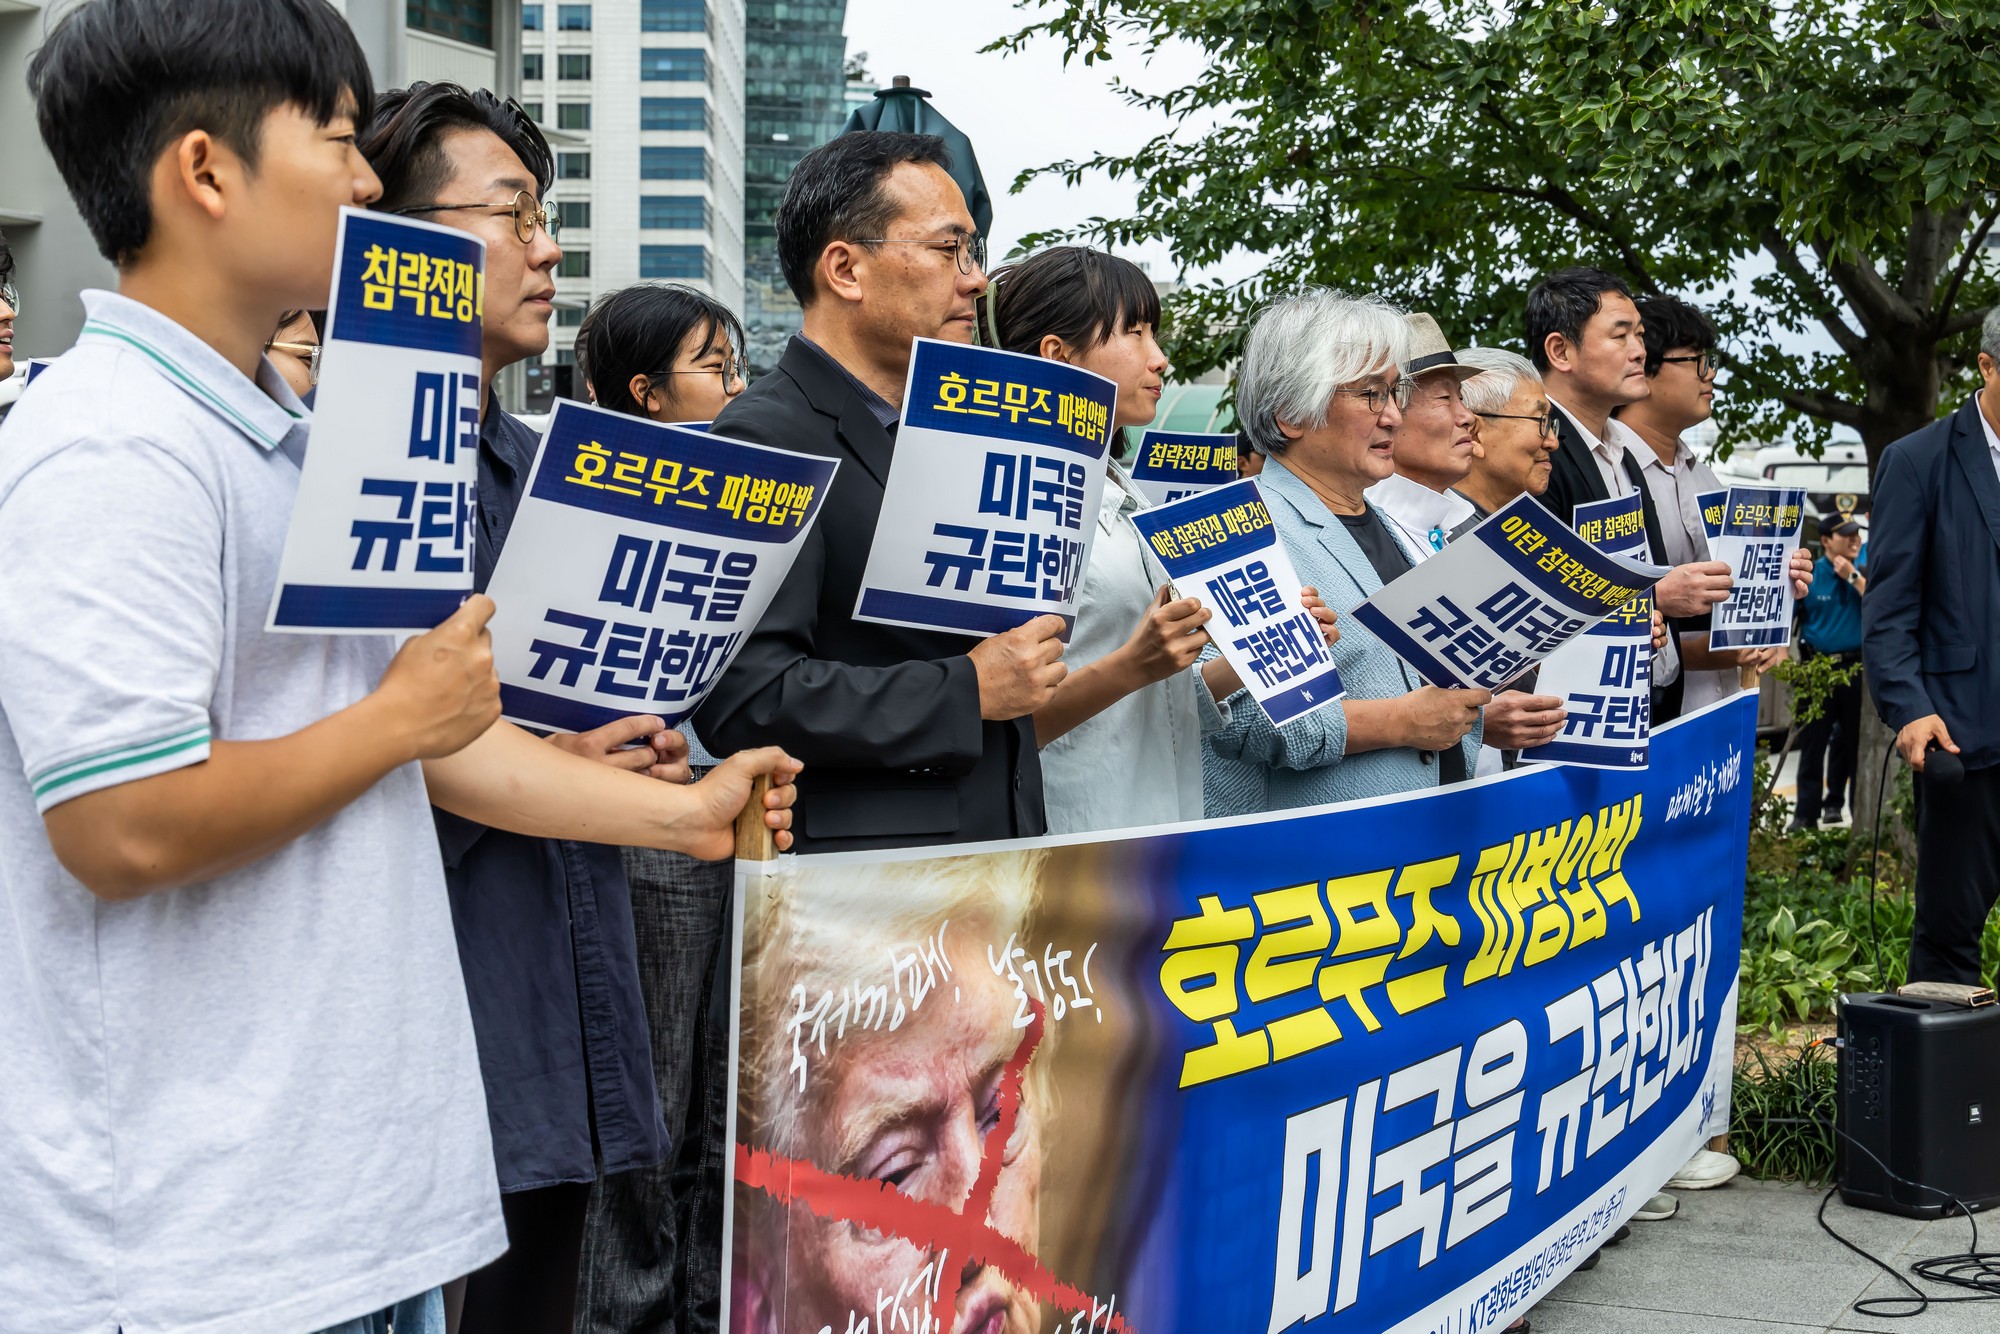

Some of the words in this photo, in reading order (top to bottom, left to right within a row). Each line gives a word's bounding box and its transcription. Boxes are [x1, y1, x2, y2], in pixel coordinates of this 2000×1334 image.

[361, 243, 474, 323] 침략전쟁
[933, 371, 1052, 425] 호르무즈
[1057, 392, 1108, 445] 파병압박
[565, 440, 714, 511] 호르무즈
[717, 474, 815, 527] 파병압박
[978, 451, 1086, 530] 미국을
[1148, 442, 1211, 471] 침략전쟁
[1151, 530, 1183, 560] 이란
[1173, 513, 1228, 555] 침략전쟁
[1221, 501, 1272, 537] 파병강요
[1580, 519, 1603, 543] 이란
[1604, 510, 1638, 540] 침략전쟁
[1704, 505, 1722, 526] 이란
[1732, 503, 1773, 528] 호르무즈
[1773, 504, 1800, 529] 파병압박
[598, 533, 758, 622] 미국을
[923, 522, 1086, 605] 규탄한다!
[1205, 560, 1287, 628] 미국을
[1501, 515, 1549, 556] 이란
[1536, 546, 1611, 599] 침략전쟁
[1738, 543, 1784, 581] 미국을
[1407, 595, 1536, 690] 규탄한
[1475, 581, 1587, 654] 미국을
[1721, 585, 1785, 624] 규탄한다!
[1231, 612, 1330, 689] 규탄한다!
[987, 931, 1103, 1026] 날강도!
[1158, 851, 1462, 1091] 호르무즈
[1462, 792, 1643, 990] 파병압박
[1267, 1017, 1529, 1334] 미국을
[1535, 904, 1715, 1197] 규탄한다!
